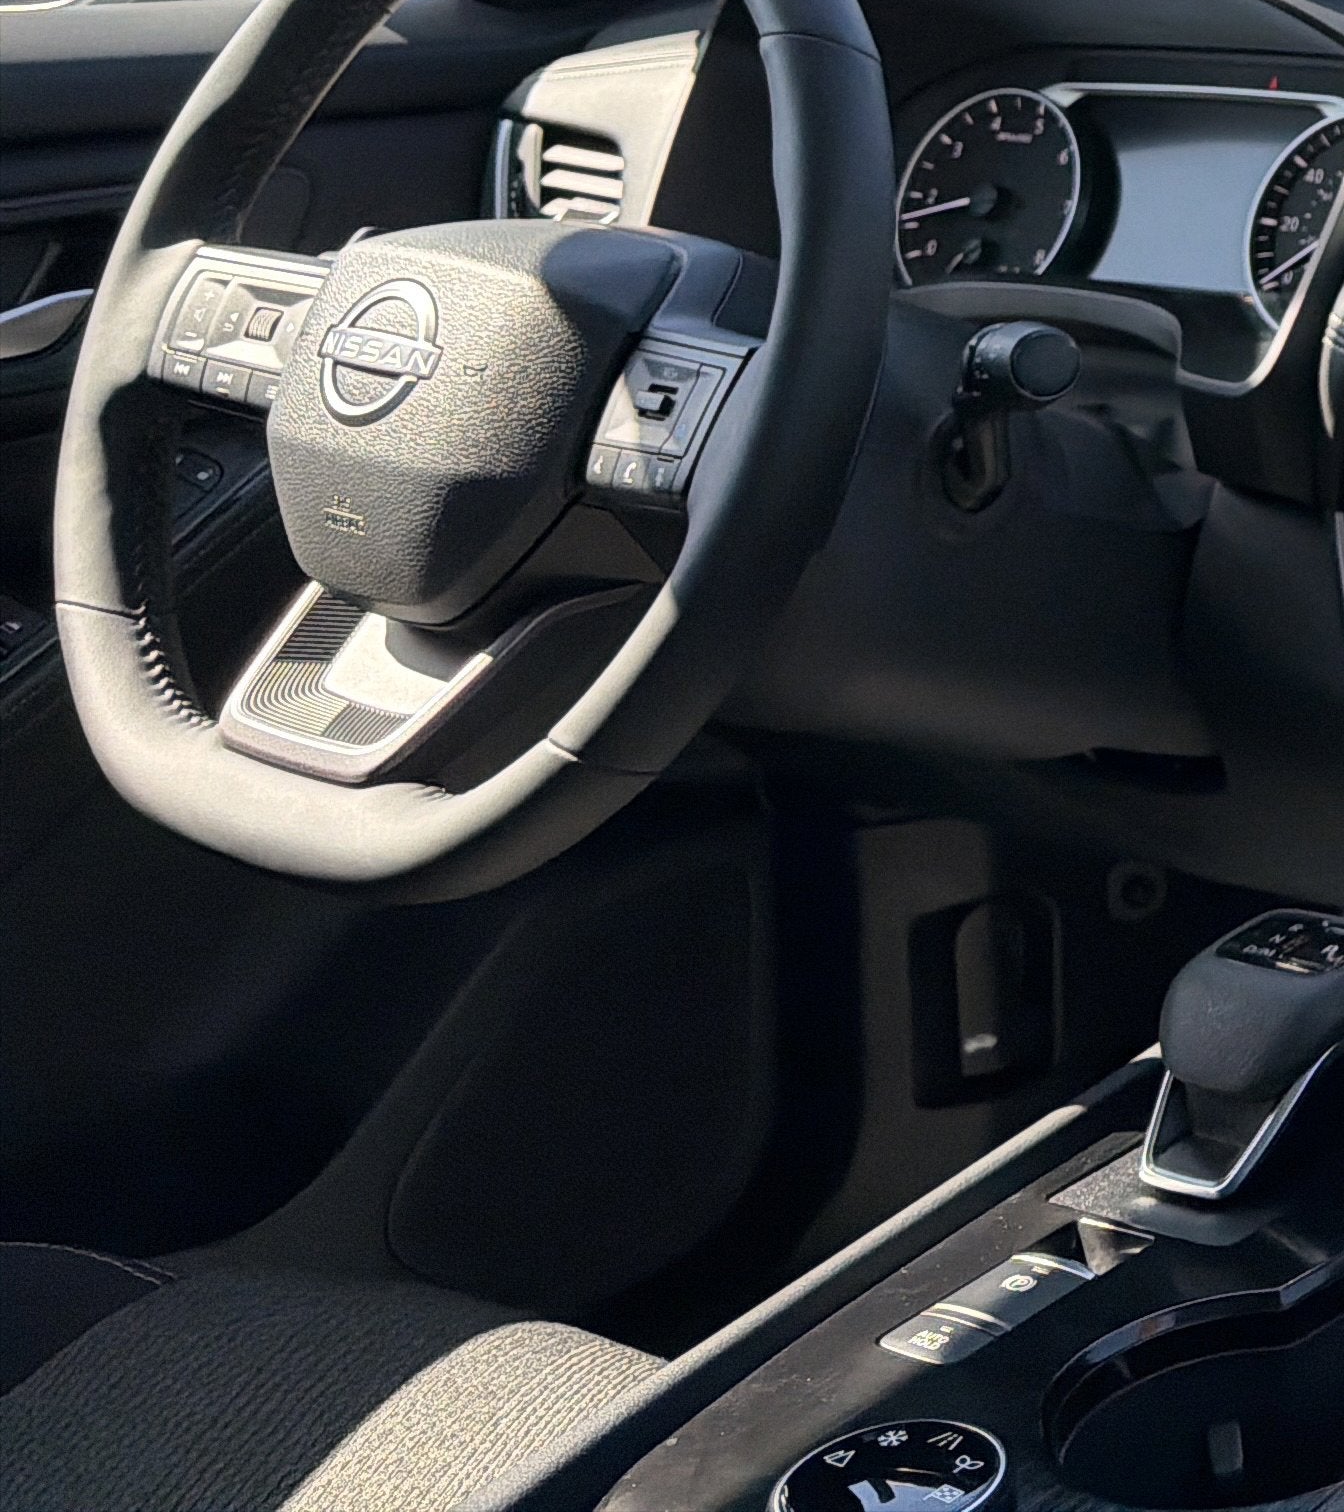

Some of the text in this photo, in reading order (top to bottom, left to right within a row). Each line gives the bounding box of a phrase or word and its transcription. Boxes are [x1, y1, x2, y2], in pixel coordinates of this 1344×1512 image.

[1304, 168, 1324, 185] 40
[1280, 215, 1300, 233] 20
[322, 331, 434, 376] NISSAN
[907, 1336, 941, 1350] HOLD
[916, 1329, 949, 1344] AUTO
